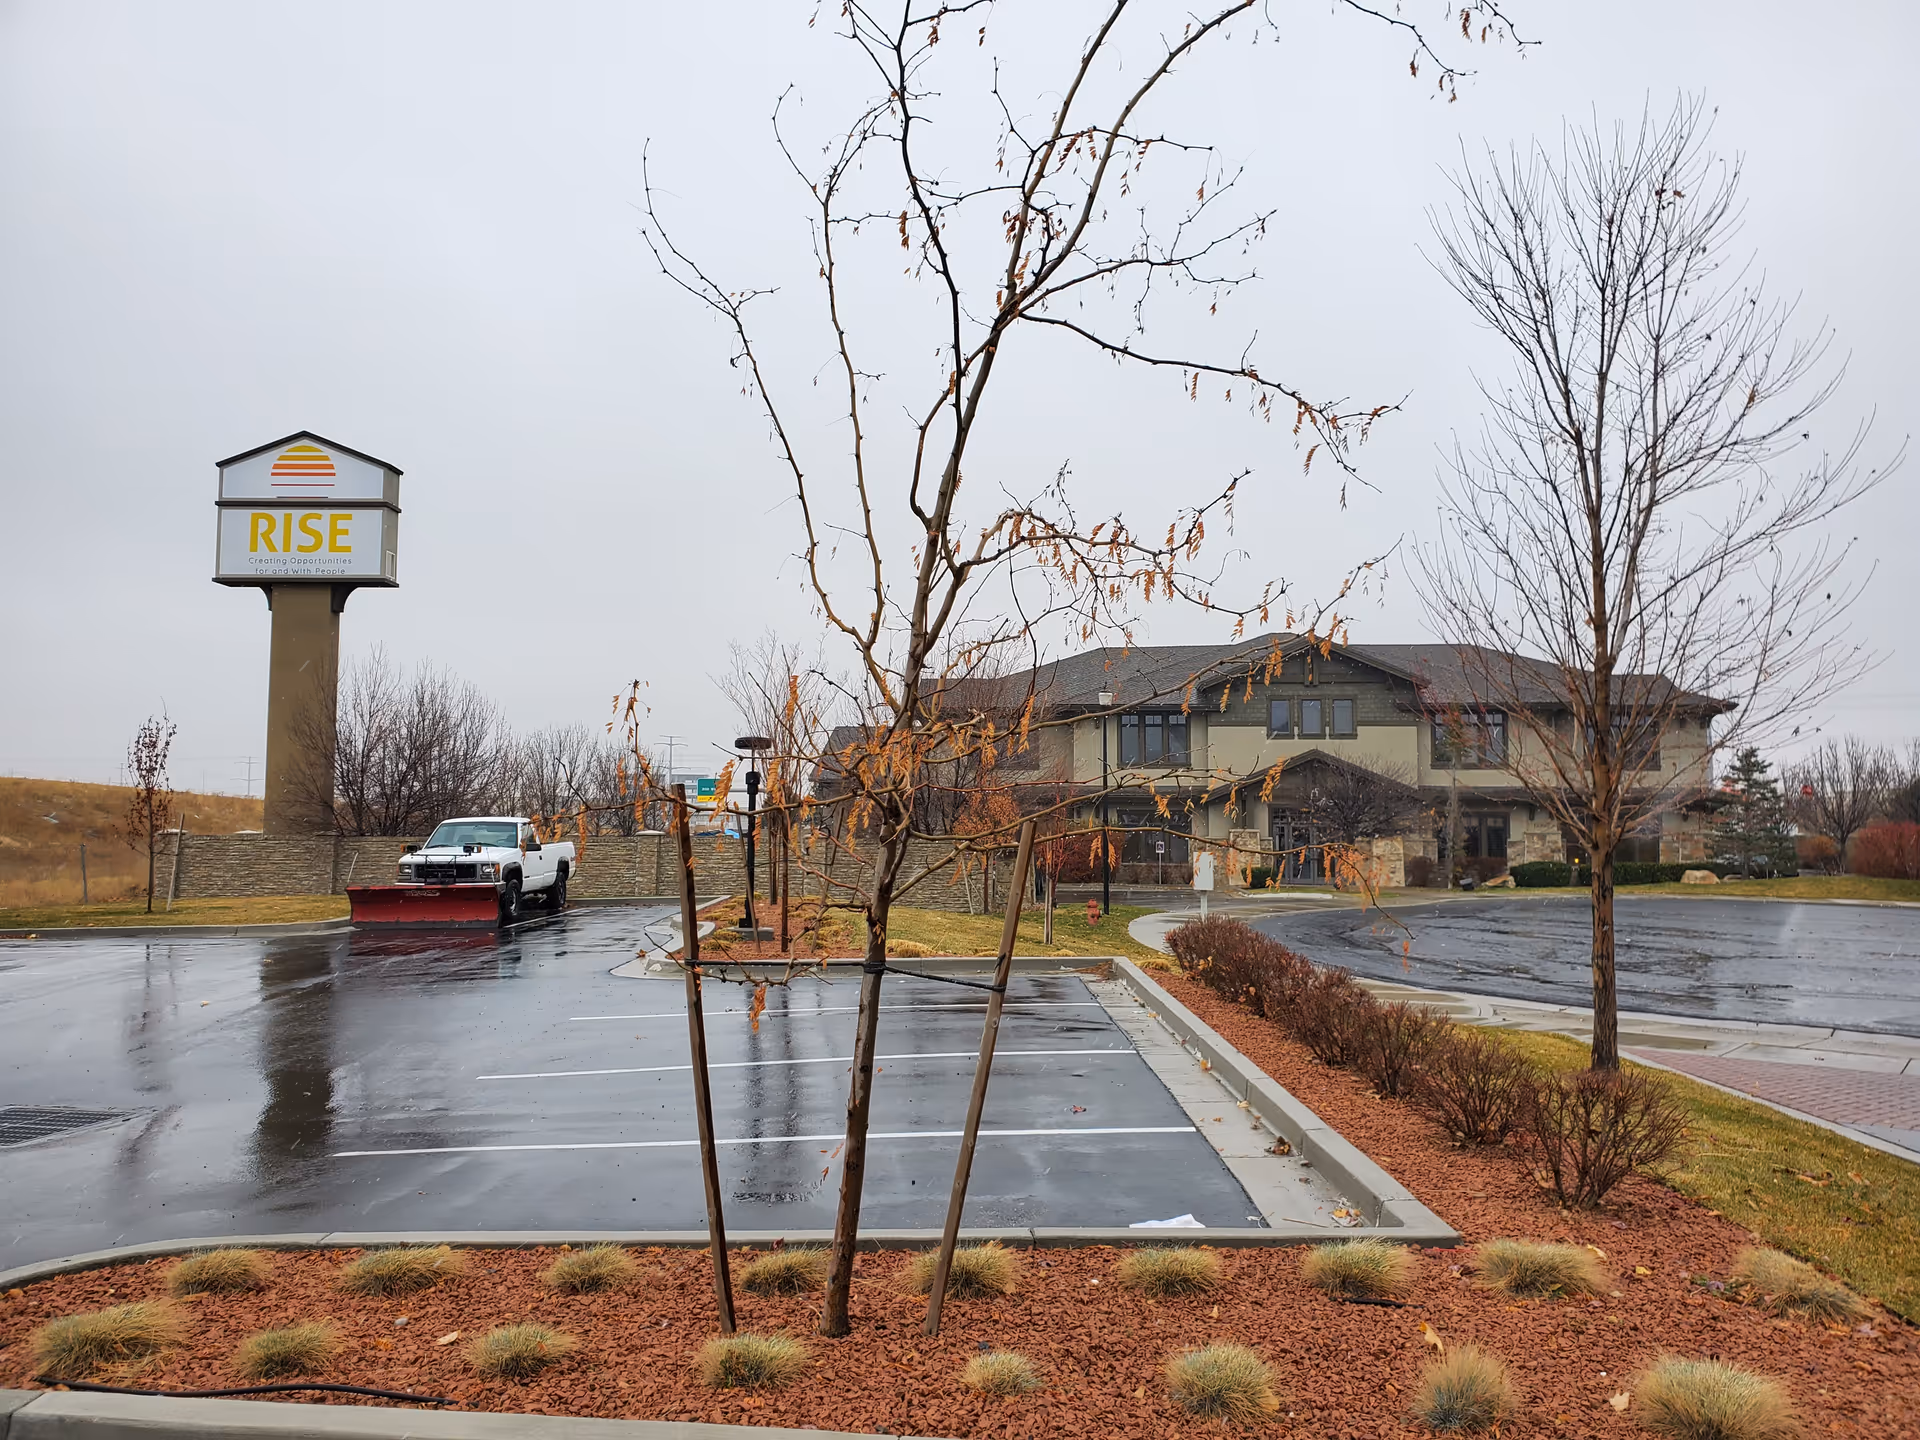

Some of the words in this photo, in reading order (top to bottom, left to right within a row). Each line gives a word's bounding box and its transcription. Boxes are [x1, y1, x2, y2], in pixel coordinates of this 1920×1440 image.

[249, 512, 353, 553] RISE
[248, 557, 287, 565] Creating
[290, 557, 352, 565] Opportunities
[315, 567, 345, 575] People
